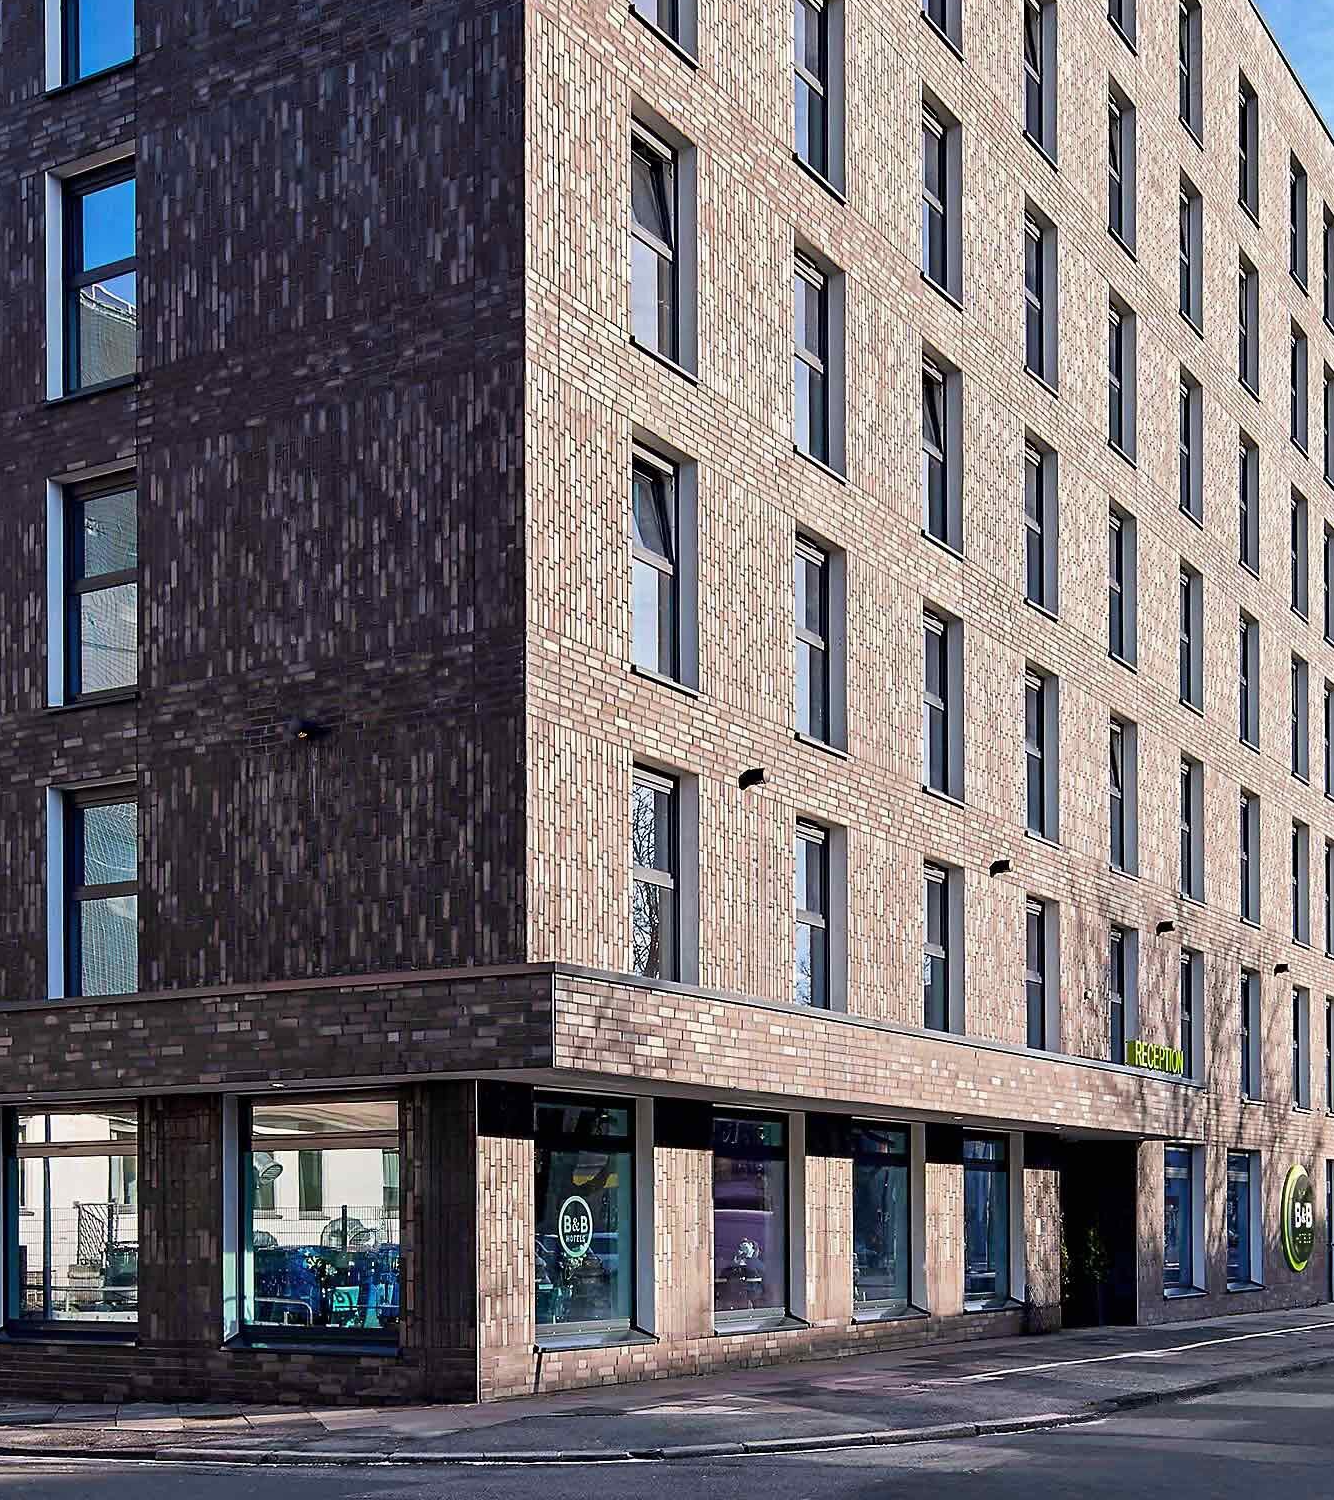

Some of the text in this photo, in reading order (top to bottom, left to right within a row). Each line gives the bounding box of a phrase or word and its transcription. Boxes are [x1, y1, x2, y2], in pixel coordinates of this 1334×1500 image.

[1135, 1041, 1184, 1075] RECEPTION
[563, 1215, 589, 1233] B&B
[1294, 1202, 1313, 1228] B&B
[565, 1234, 586, 1243] HOTELS
